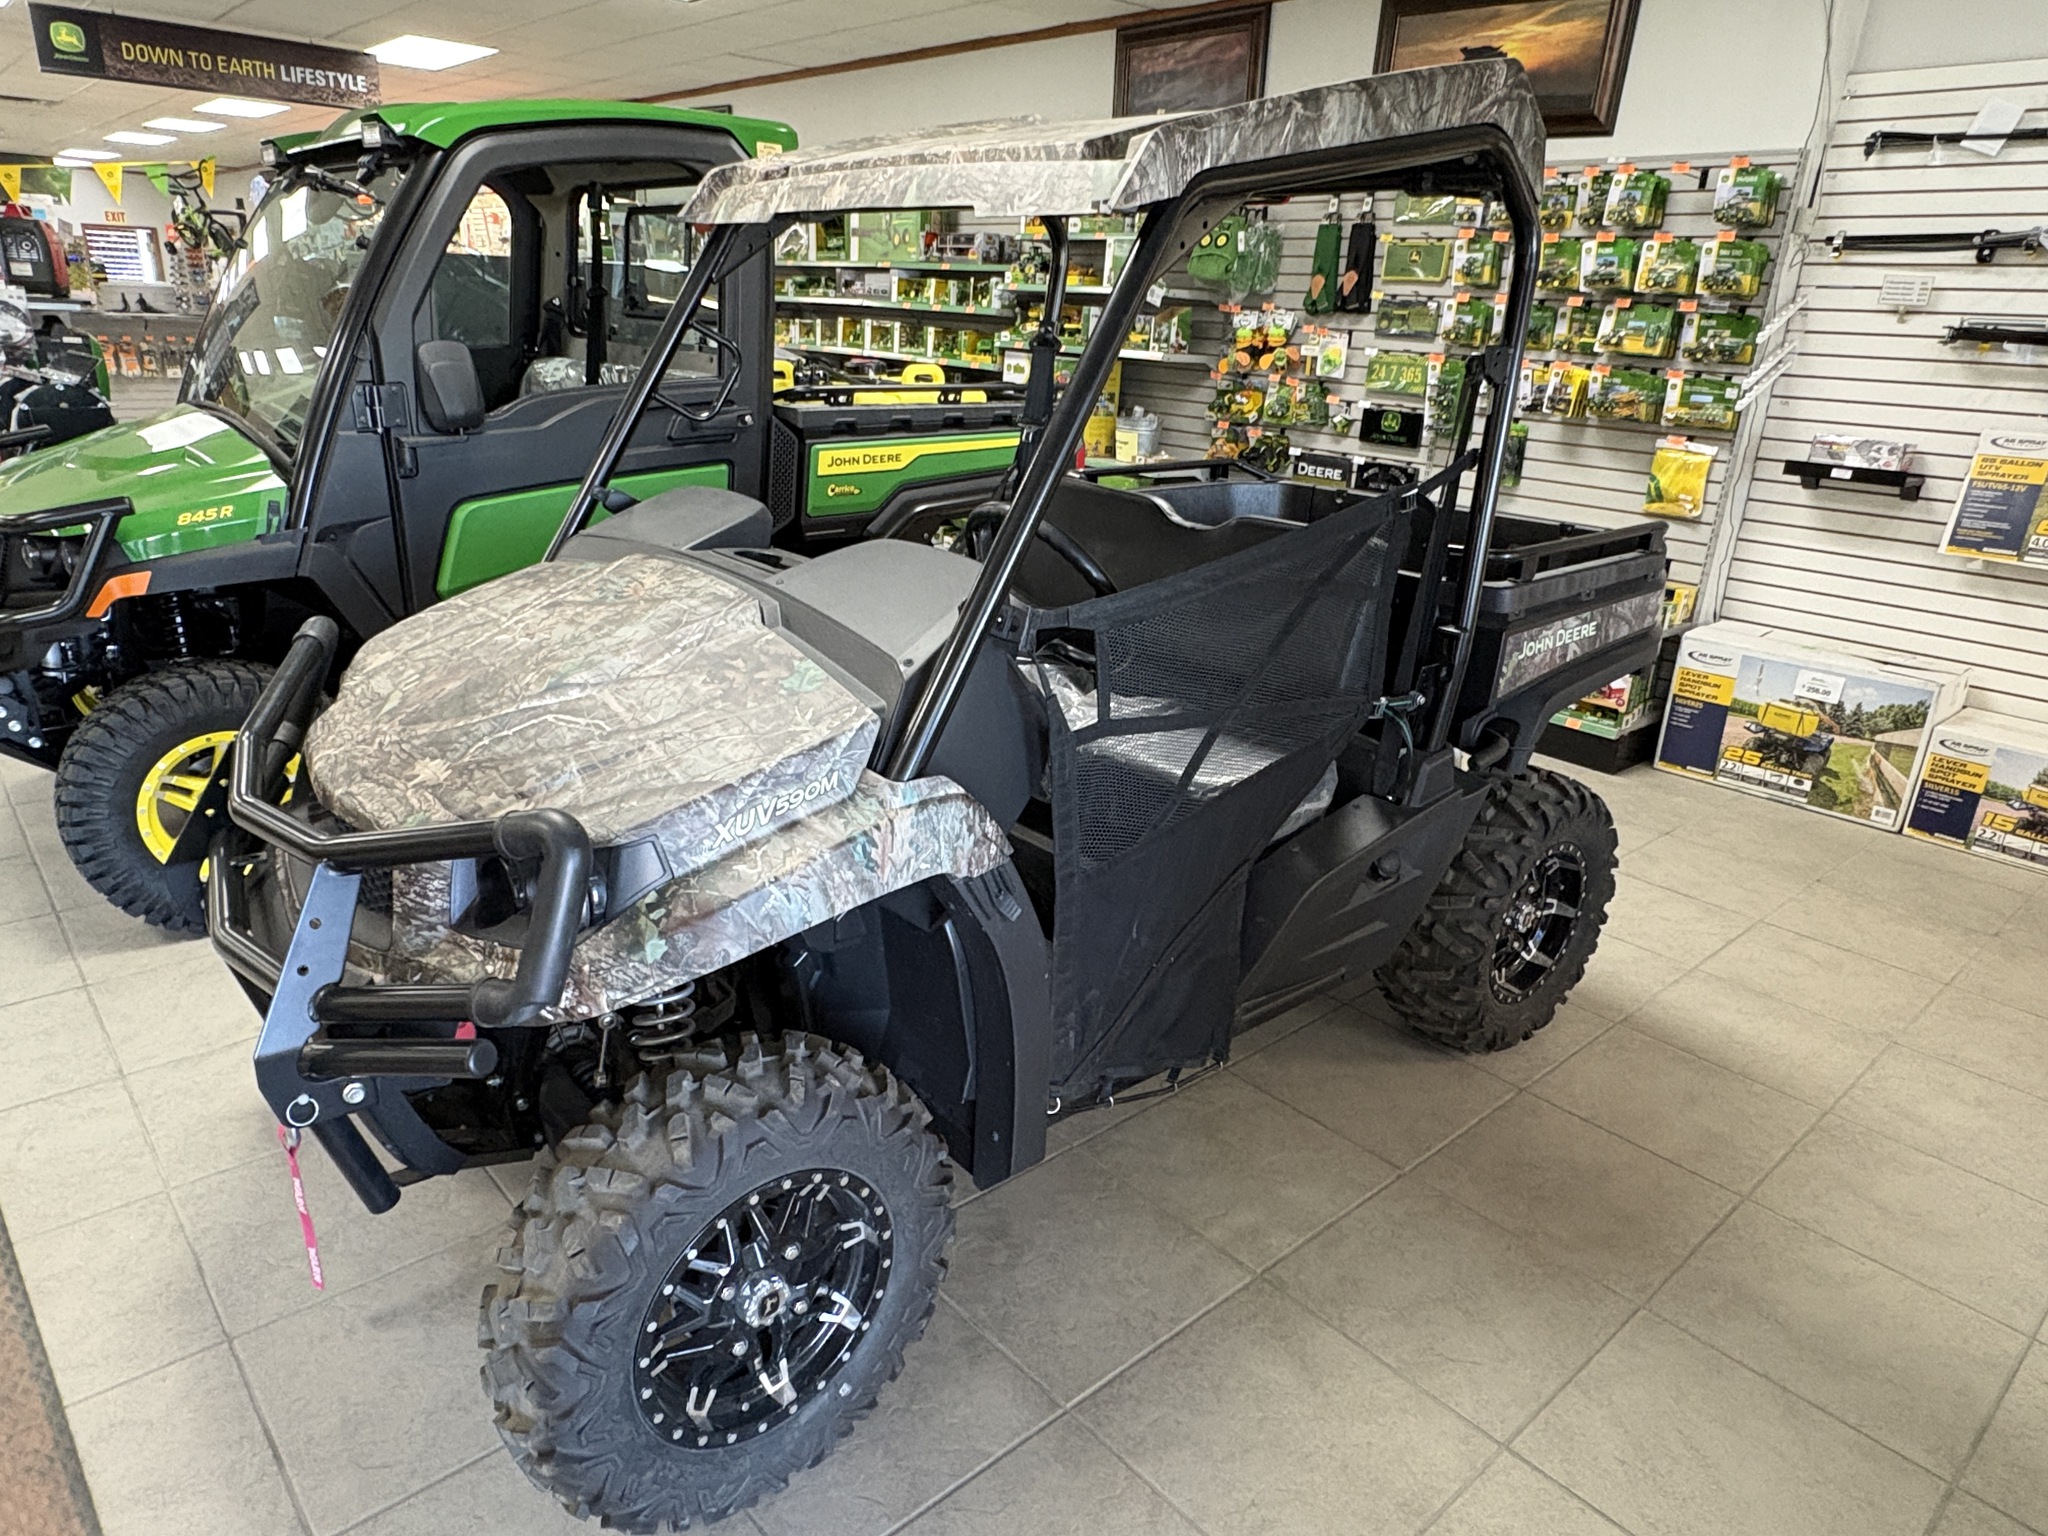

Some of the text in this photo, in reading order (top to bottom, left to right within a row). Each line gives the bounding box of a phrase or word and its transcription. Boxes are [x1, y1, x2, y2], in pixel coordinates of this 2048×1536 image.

[121, 41, 368, 93] DOWN TO EARTH LIFESTYLE
[104, 210, 126, 223] EXIT
[1371, 364, 1422, 384] 24 7 365
[2019, 438, 2047, 446] SPRAY
[827, 453, 903, 468] JOHN DEERE
[1999, 458, 2045, 468] GALLON
[1297, 461, 1343, 481] DEERE
[1976, 470, 2030, 480] SPRAYER
[1517, 621, 1598, 660] JOHN DEERE
[1681, 670, 1710, 680] LEVER
[1678, 682, 1703, 691] SPOT
[1680, 676, 1722, 690] HANDGUN
[1677, 688, 1719, 701] SPRAYER
[1723, 745, 1764, 766] 25
[1932, 756, 1968, 769] LEVER
[1929, 767, 1958, 778] SPOT
[1931, 762, 1984, 779] HANDGUN
[1923, 781, 1960, 796] SILVER15
[1927, 773, 1978, 790] SPRAYER
[712, 770, 840, 850] XUV590M
[1981, 810, 2018, 833] 15
